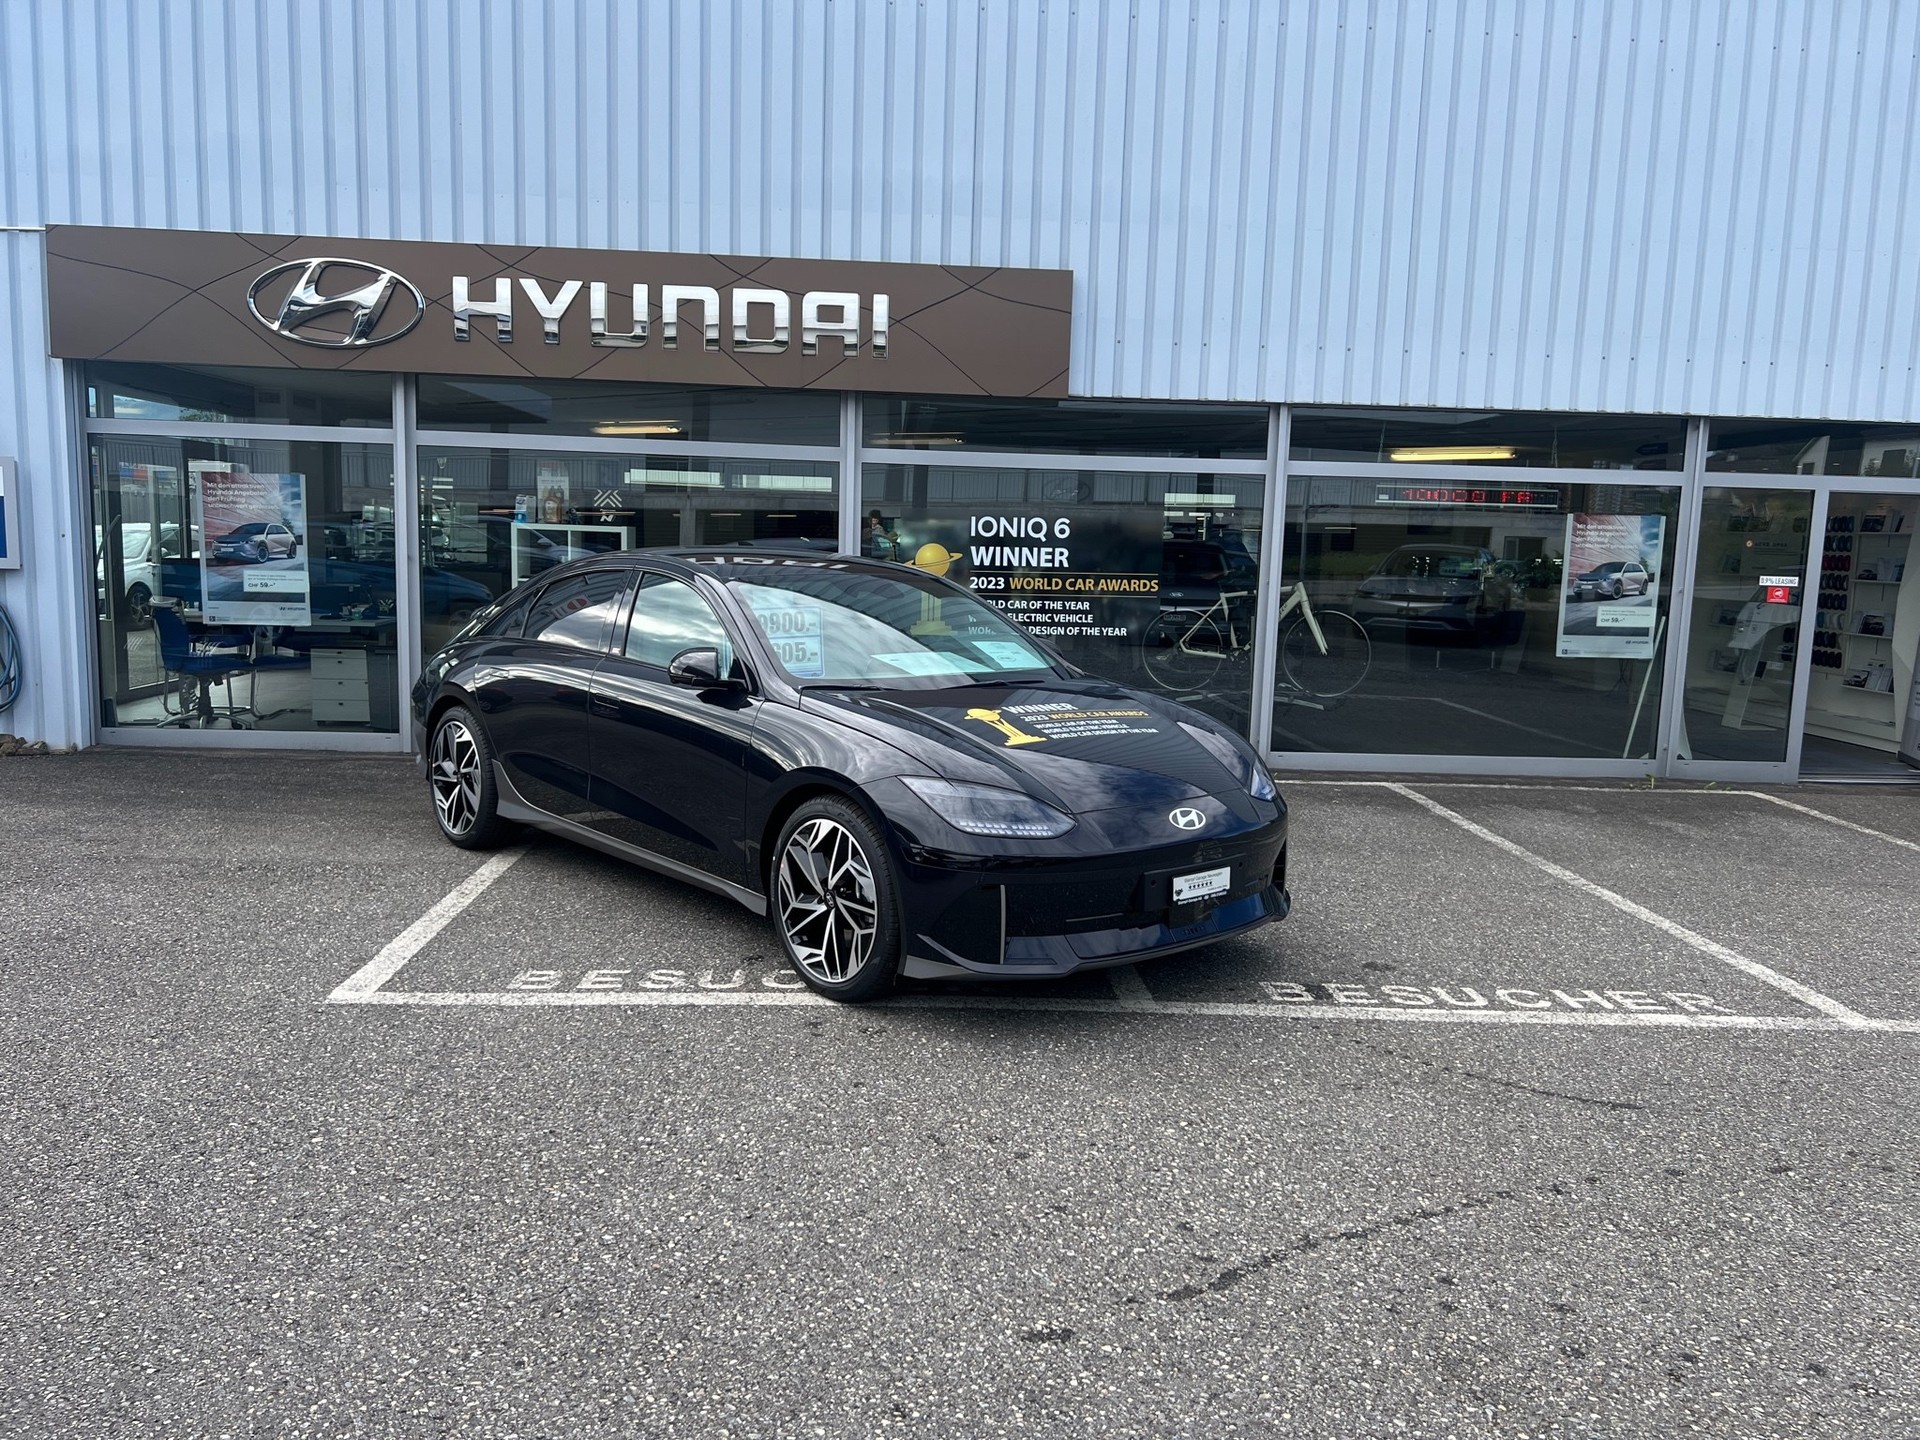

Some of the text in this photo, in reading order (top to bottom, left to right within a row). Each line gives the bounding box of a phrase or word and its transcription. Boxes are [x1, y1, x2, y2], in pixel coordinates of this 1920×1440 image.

[452, 276, 889, 359] HYUNDAI
[970, 516, 1070, 542] IONIQ 6
[970, 546, 1069, 568] WINNER
[970, 576, 1158, 592] 2023 WORLD CAR AWARDS
[1008, 600, 1027, 609] CAR
[1029, 600, 1042, 610] OF
[1044, 601, 1064, 610] THE
[1065, 601, 1090, 610] YEAR
[1008, 613, 1094, 622] ELECTRIC VEHICLE
[1028, 626, 1064, 635] DESIGN
[1066, 627, 1080, 635] OF
[1080, 627, 1100, 636] THE
[1101, 628, 1127, 636] YEAR
[1001, 703, 1078, 714] WINNER
[506, 969, 807, 990] BESUC
[1259, 981, 1739, 1013] BESUCHER
